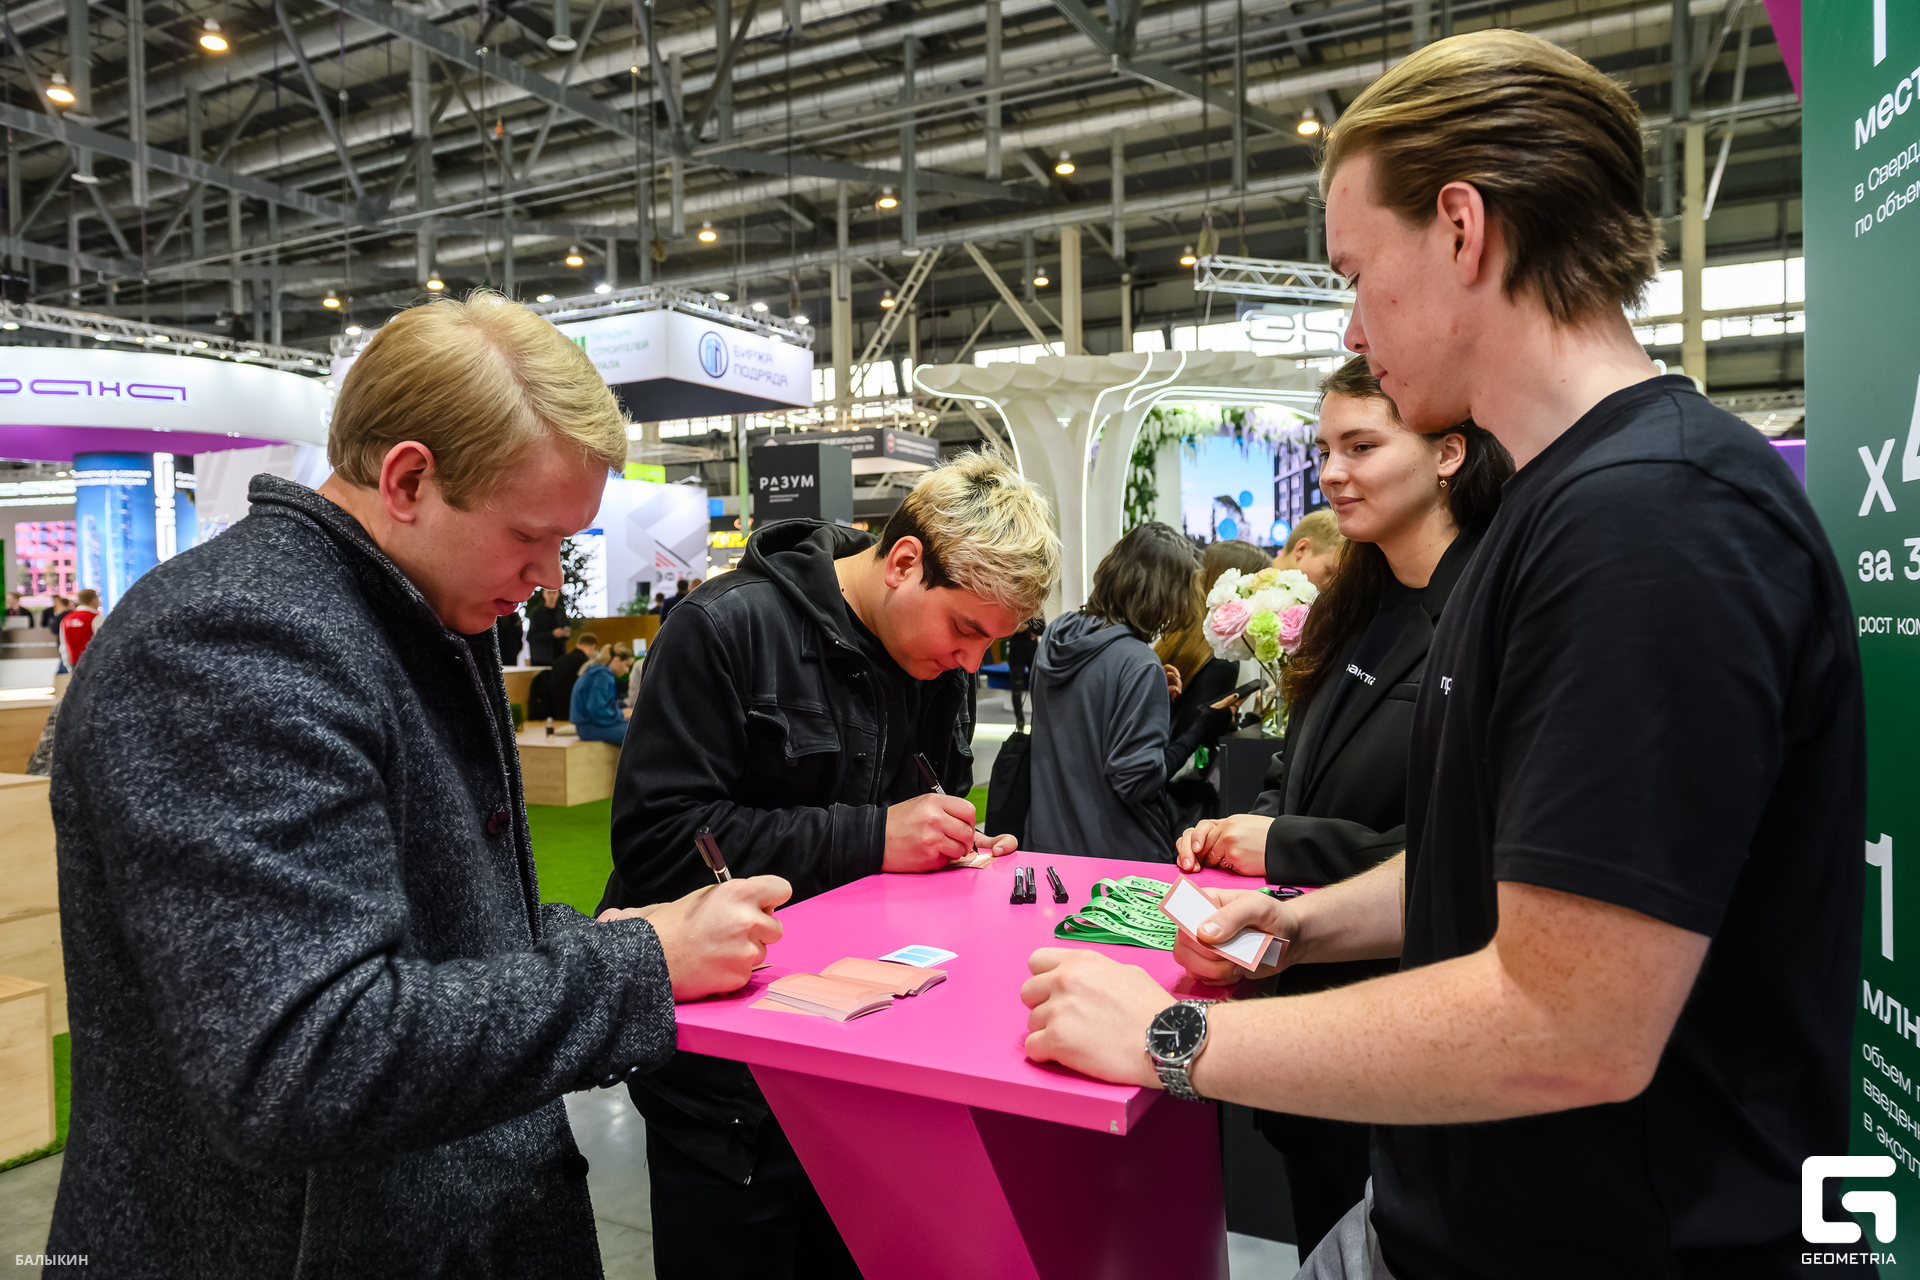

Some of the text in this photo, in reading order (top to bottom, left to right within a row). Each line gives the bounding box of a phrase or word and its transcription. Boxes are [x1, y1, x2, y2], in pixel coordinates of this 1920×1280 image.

[1855, 139, 1920, 202] в Сверд
[1855, 213, 1873, 238] по
[1858, 549, 1894, 582] за
[1859, 616, 1893, 637] рост
[1865, 832, 1894, 962] 1
[1863, 1043, 1912, 1095] объем
[1863, 1077, 1920, 1140] введен
[1863, 1112, 1873, 1132] в
